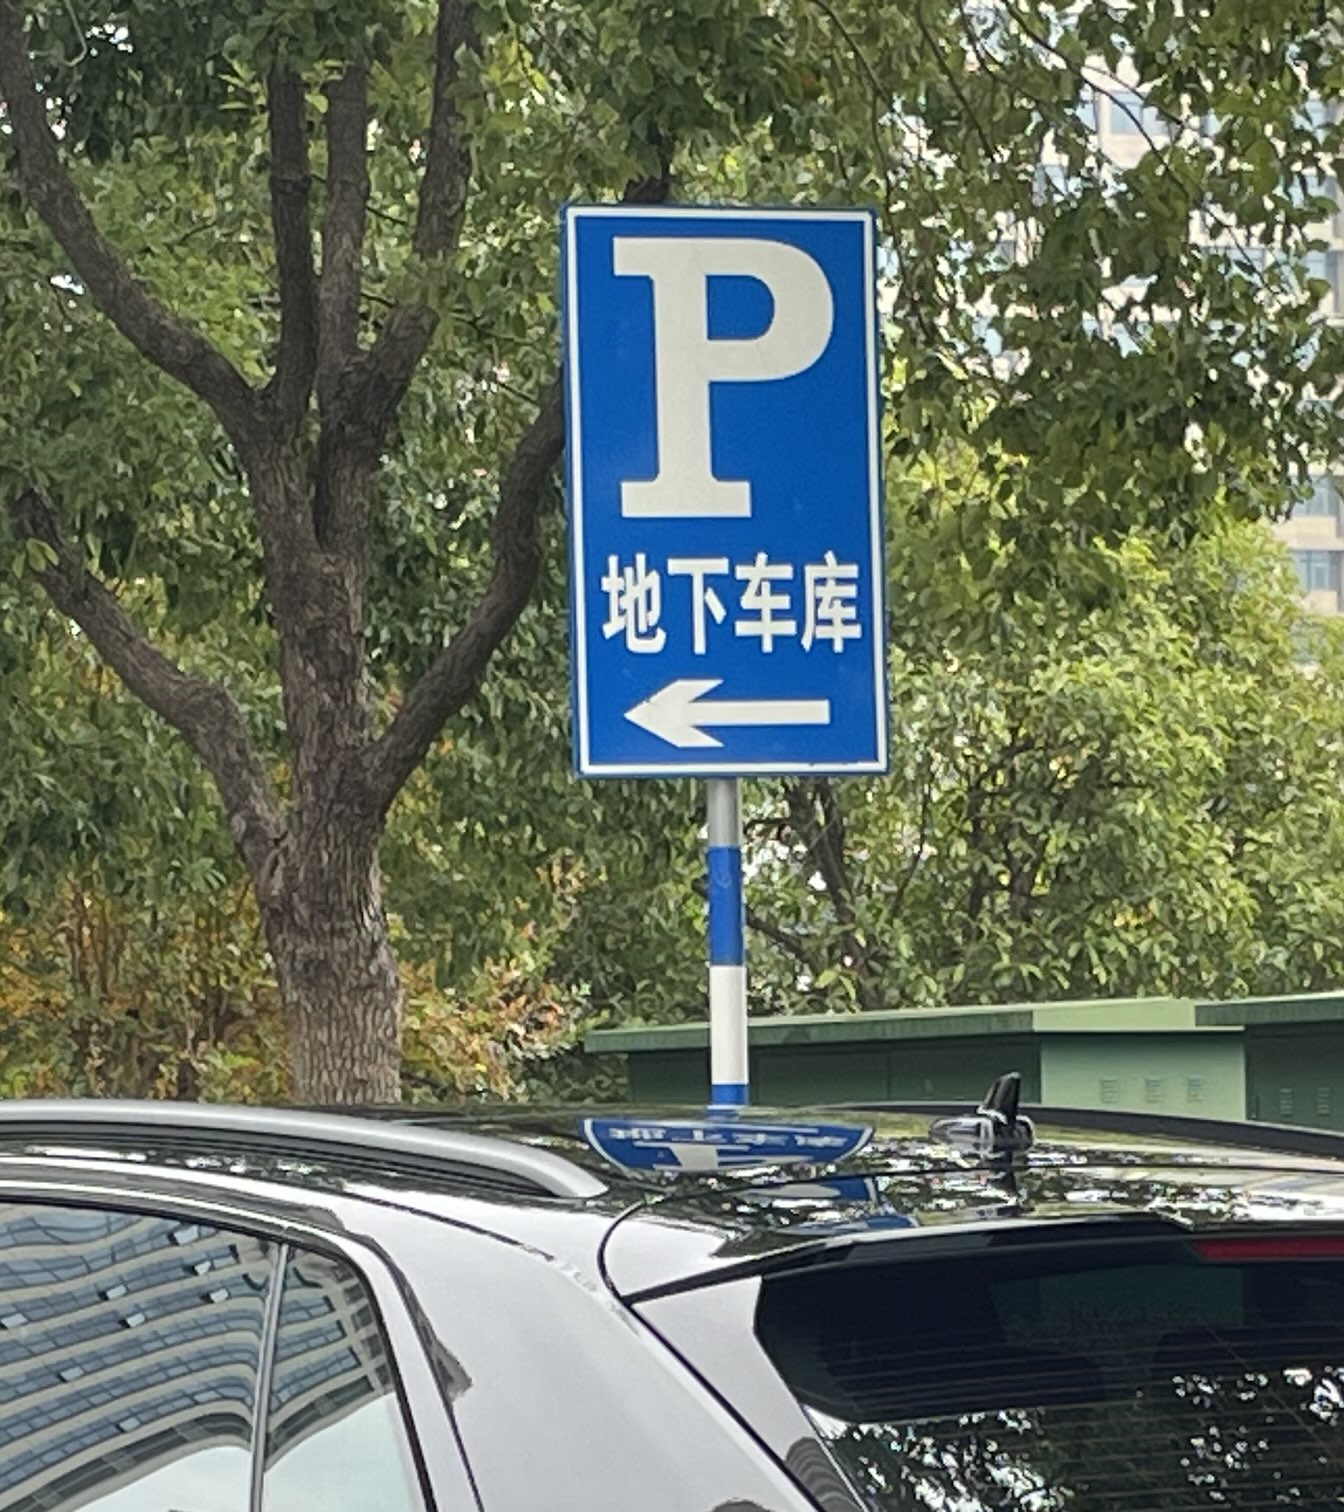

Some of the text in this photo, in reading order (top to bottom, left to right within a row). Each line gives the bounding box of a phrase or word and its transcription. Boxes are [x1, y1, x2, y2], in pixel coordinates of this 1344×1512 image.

[612, 236, 834, 518] P
[600, 550, 862, 656] 地下车库
